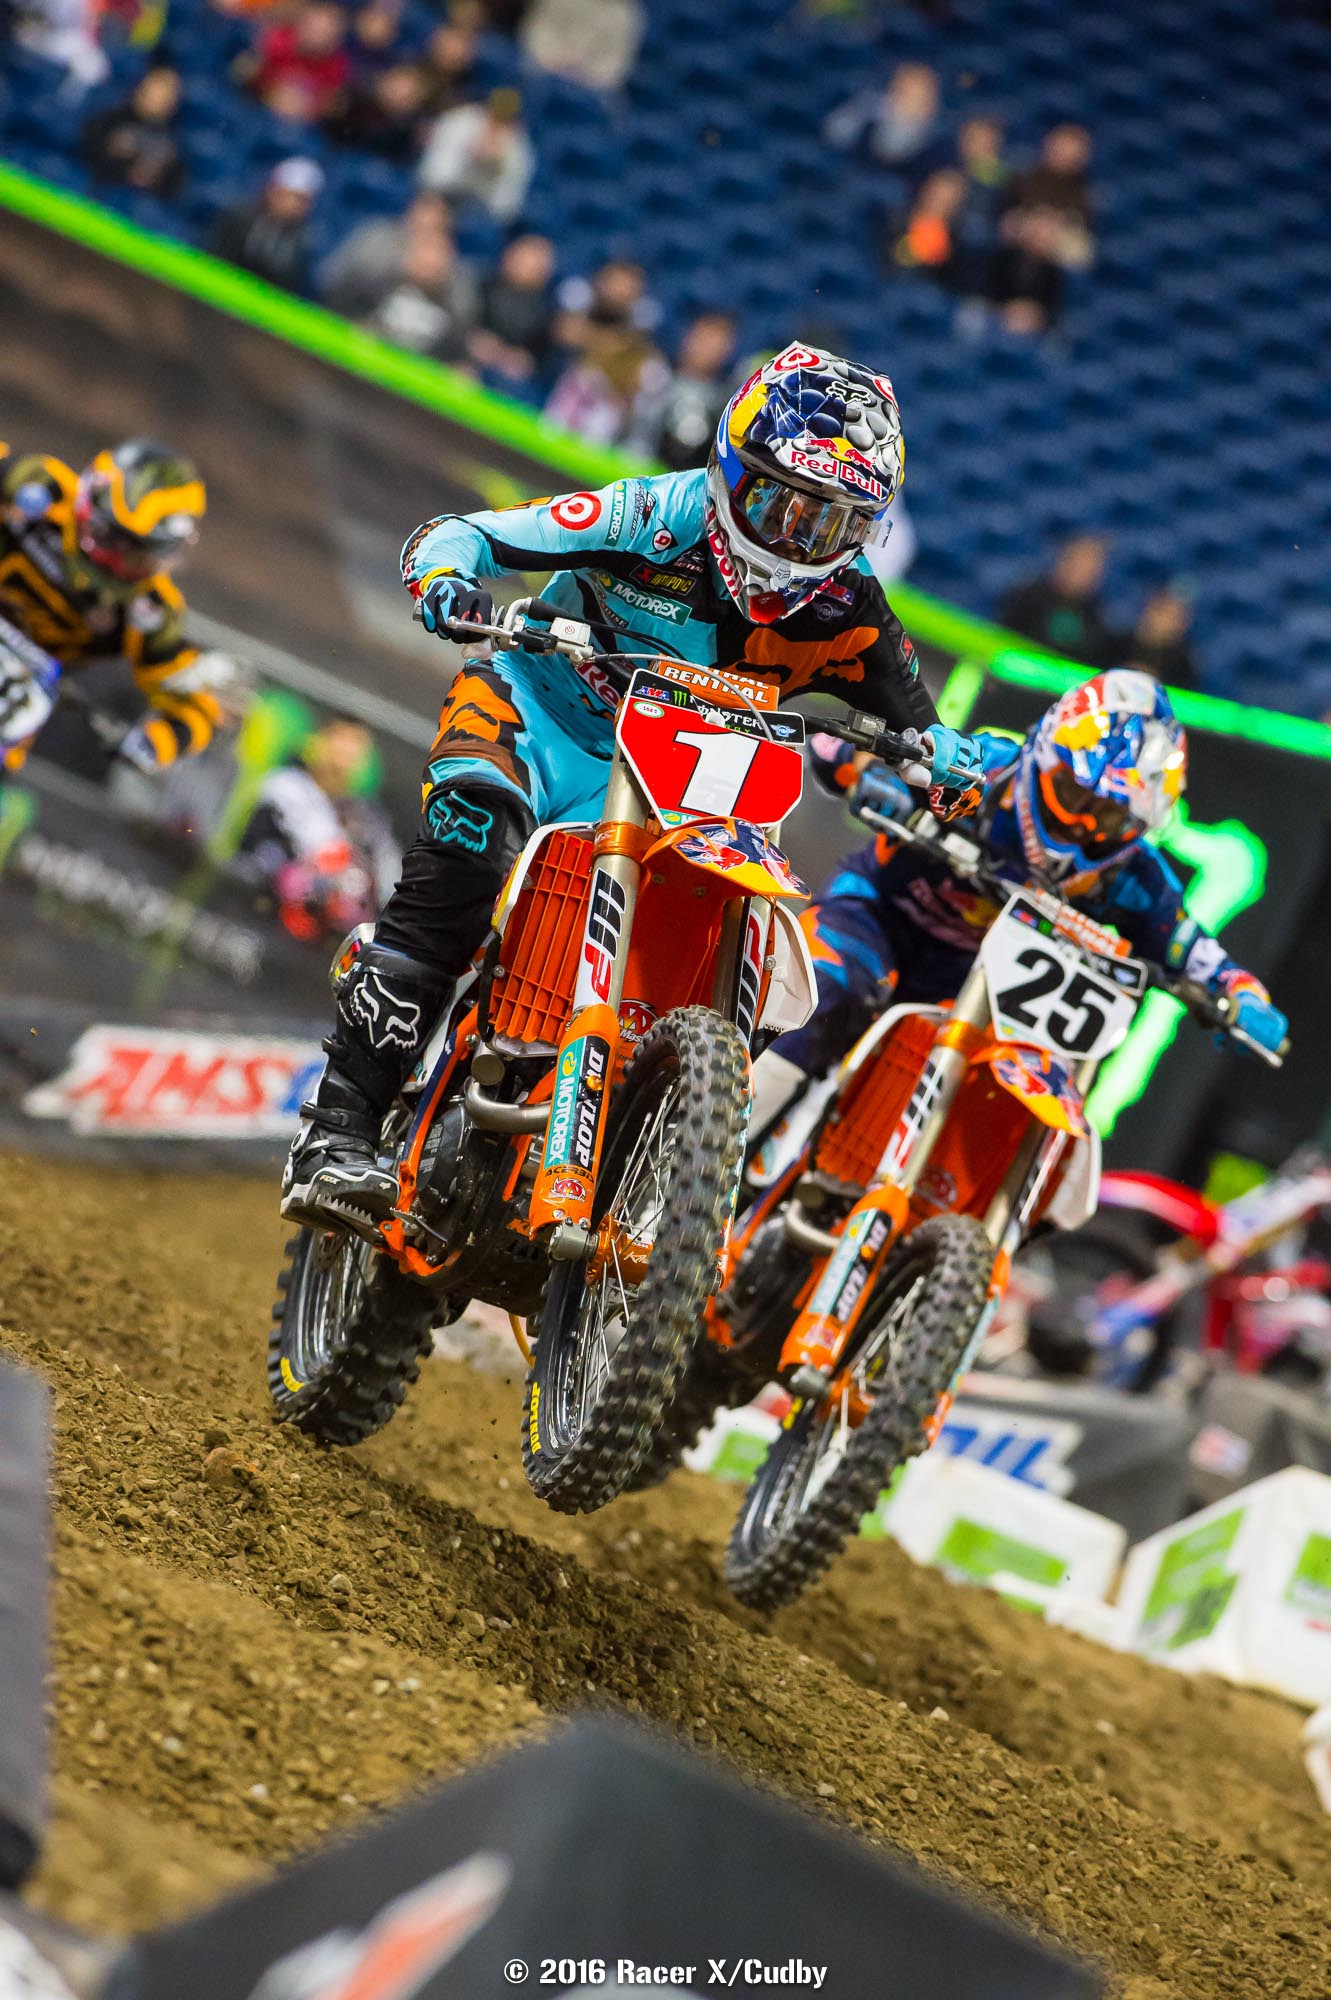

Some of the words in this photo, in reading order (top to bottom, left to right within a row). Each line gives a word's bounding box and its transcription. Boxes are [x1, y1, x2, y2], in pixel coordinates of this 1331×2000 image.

[791, 451, 838, 476] Red
[840, 461, 882, 499] Bull
[608, 491, 625, 541] MOTOREX
[613, 583, 682, 620] MOTOREX
[635, 685, 670, 701] AMA
[663, 666, 769, 704] RENTHAL
[673, 729, 761, 817] 1
[997, 948, 1117, 1054] 25
[549, 1076, 575, 1164] MOTOREX
[529, 1381, 541, 1455] DUNLOP
